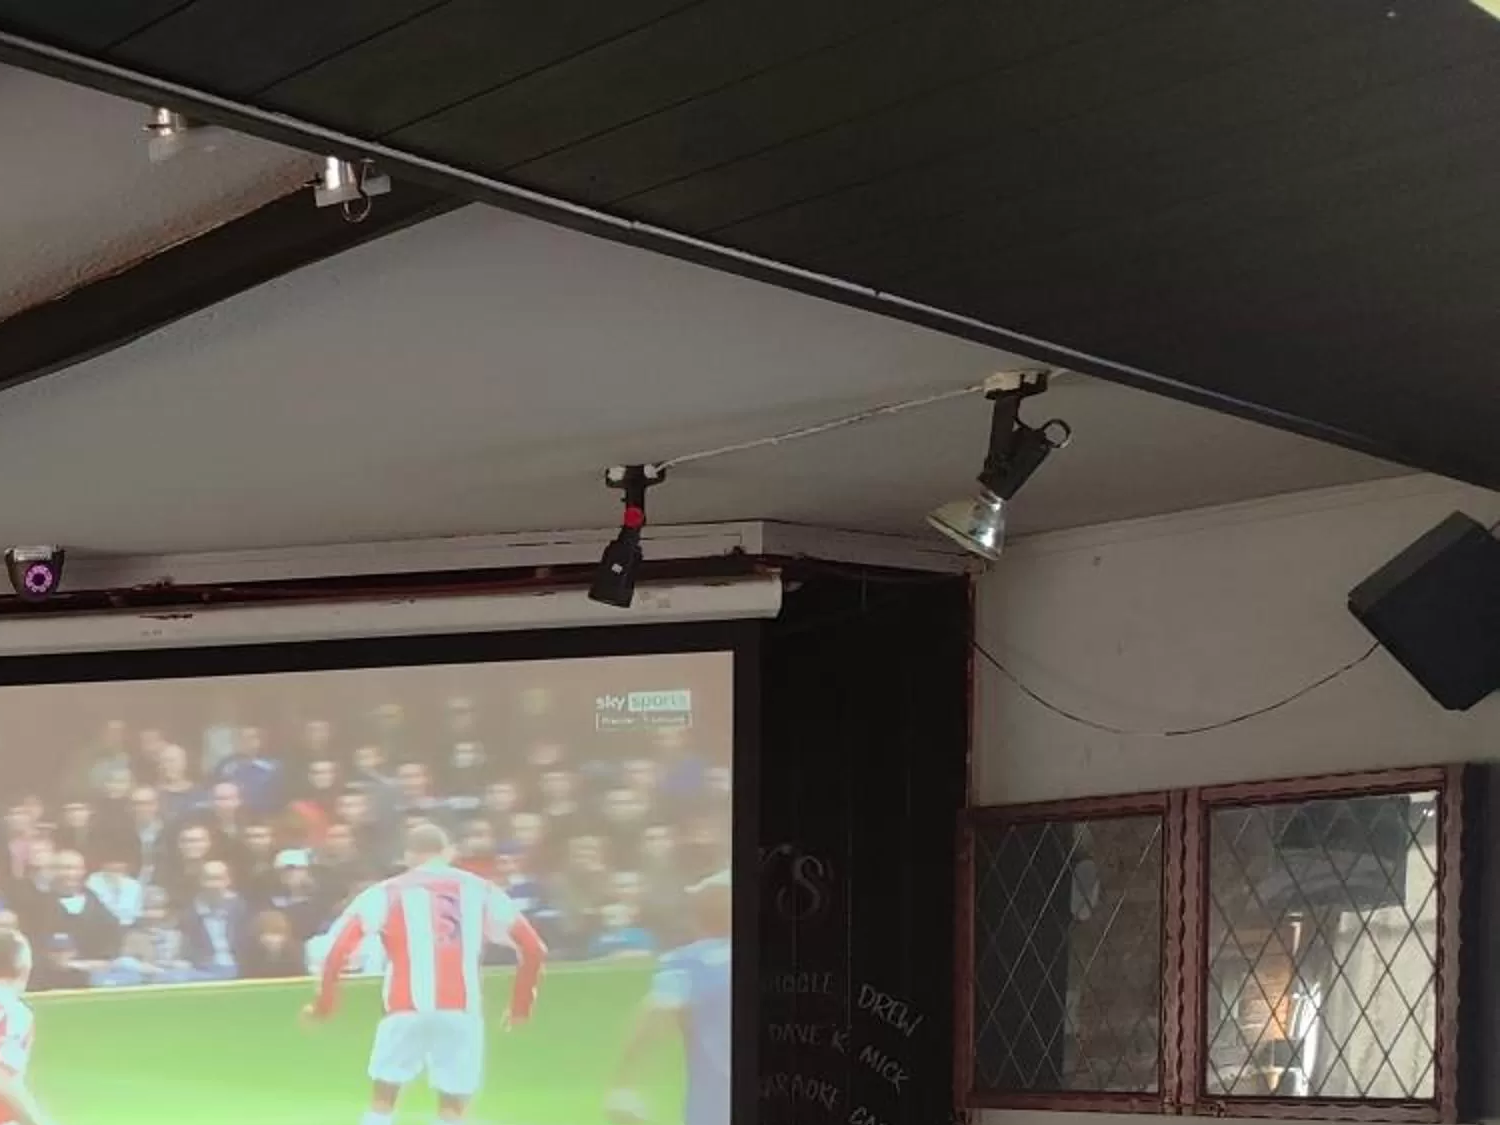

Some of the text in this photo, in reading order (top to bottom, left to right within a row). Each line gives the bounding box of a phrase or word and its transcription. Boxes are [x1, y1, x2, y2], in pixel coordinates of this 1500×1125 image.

[595, 692, 626, 712] sky
[857, 982, 925, 1037] DREW
[858, 1043, 911, 1096] MICK
